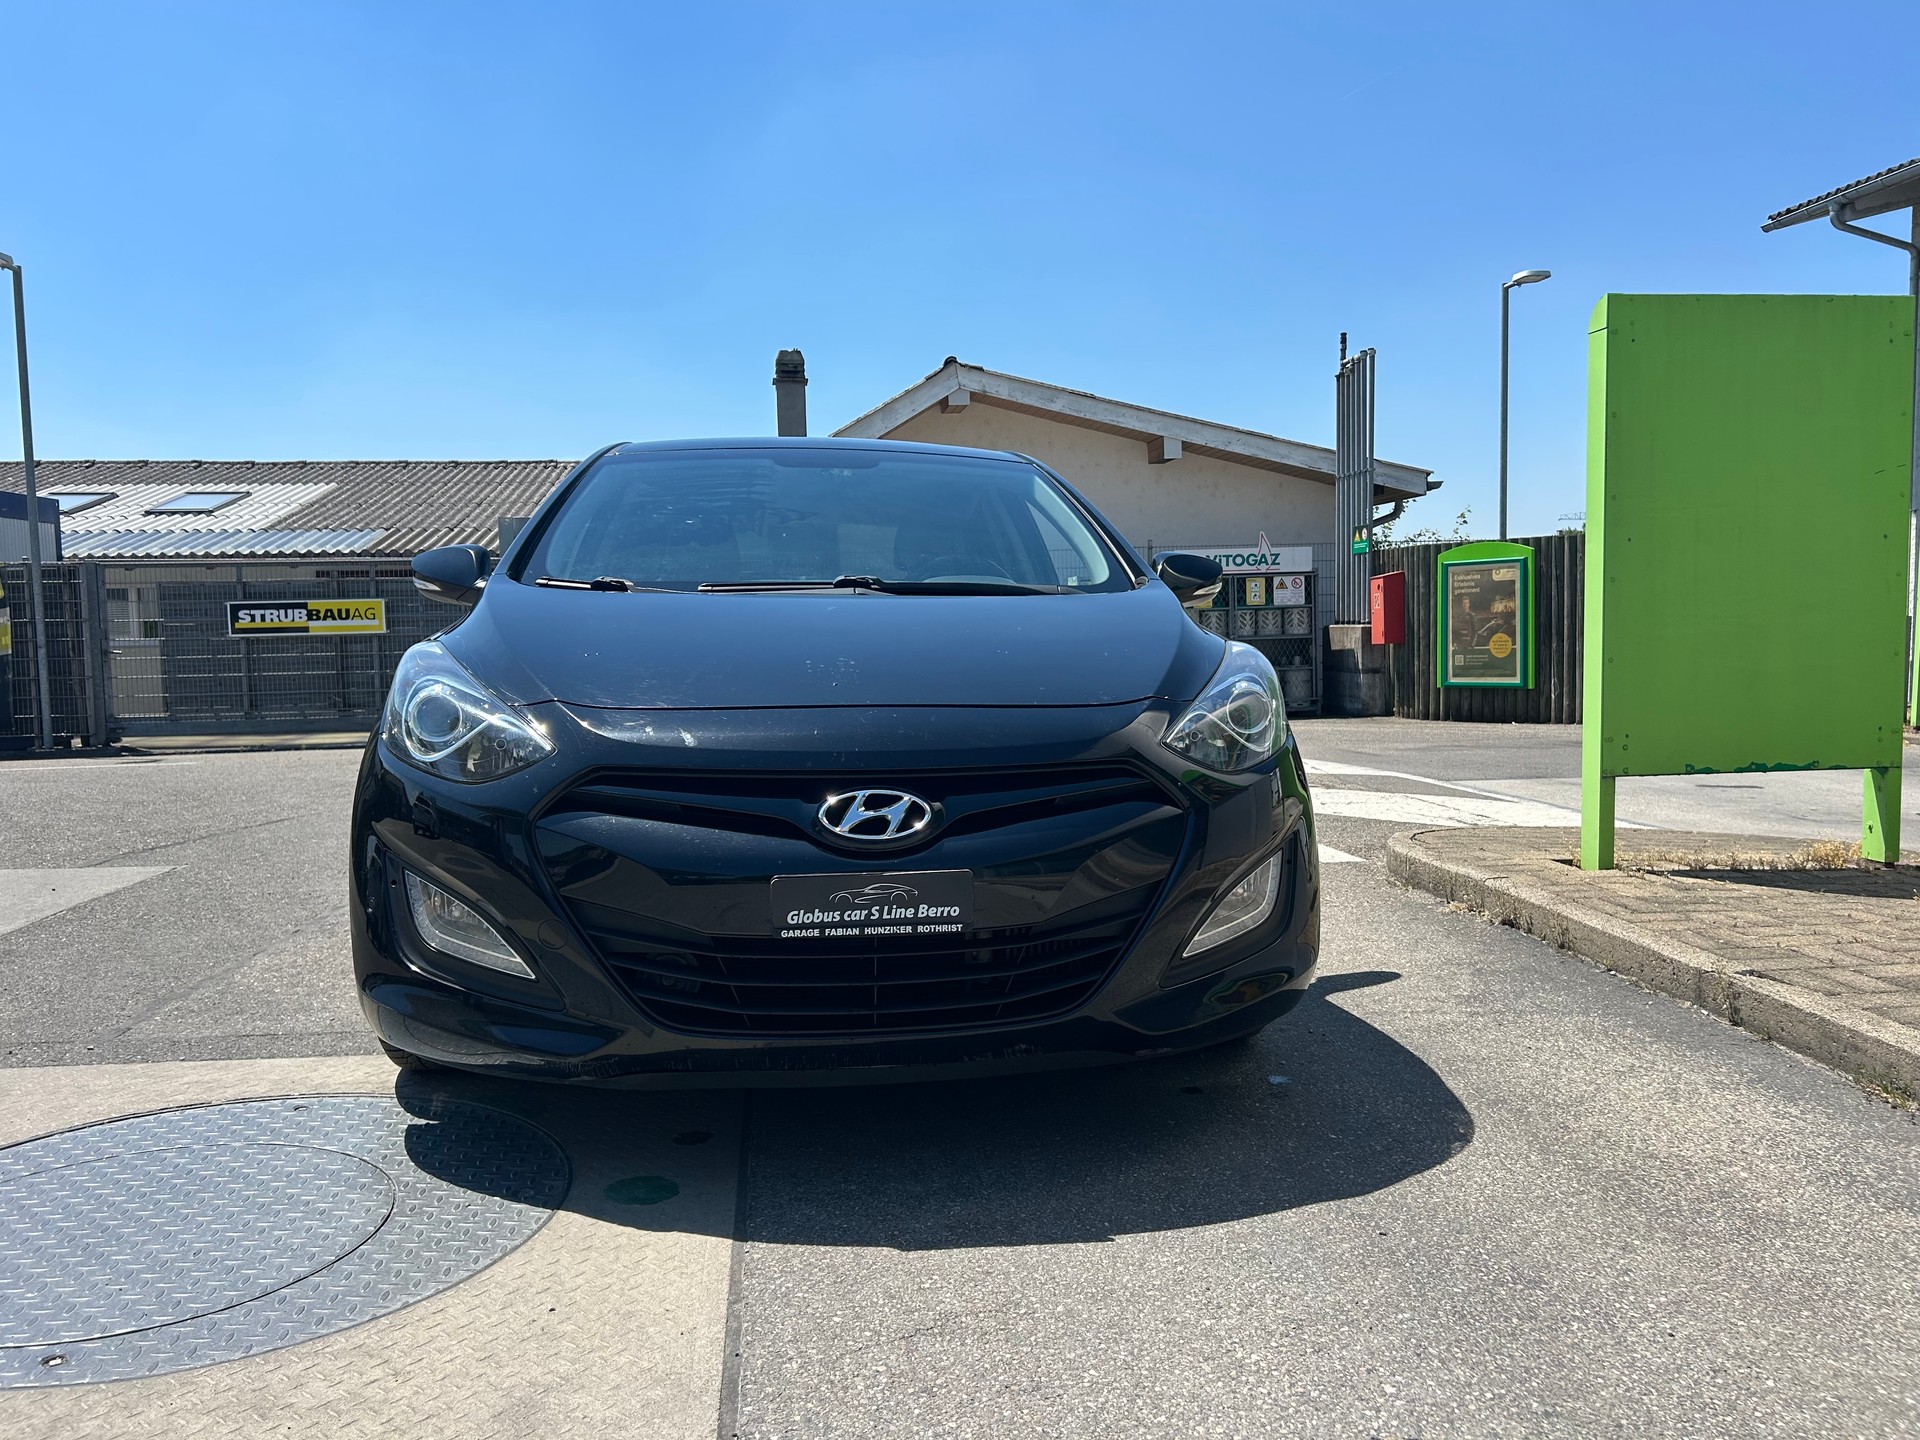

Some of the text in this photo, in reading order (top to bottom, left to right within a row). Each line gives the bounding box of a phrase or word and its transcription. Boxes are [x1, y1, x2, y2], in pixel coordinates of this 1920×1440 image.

[786, 904, 960, 925] Globus car S Line Berro
[781, 924, 963, 938] GARAGE FABIAN HUNZIKER ROTHRIST
